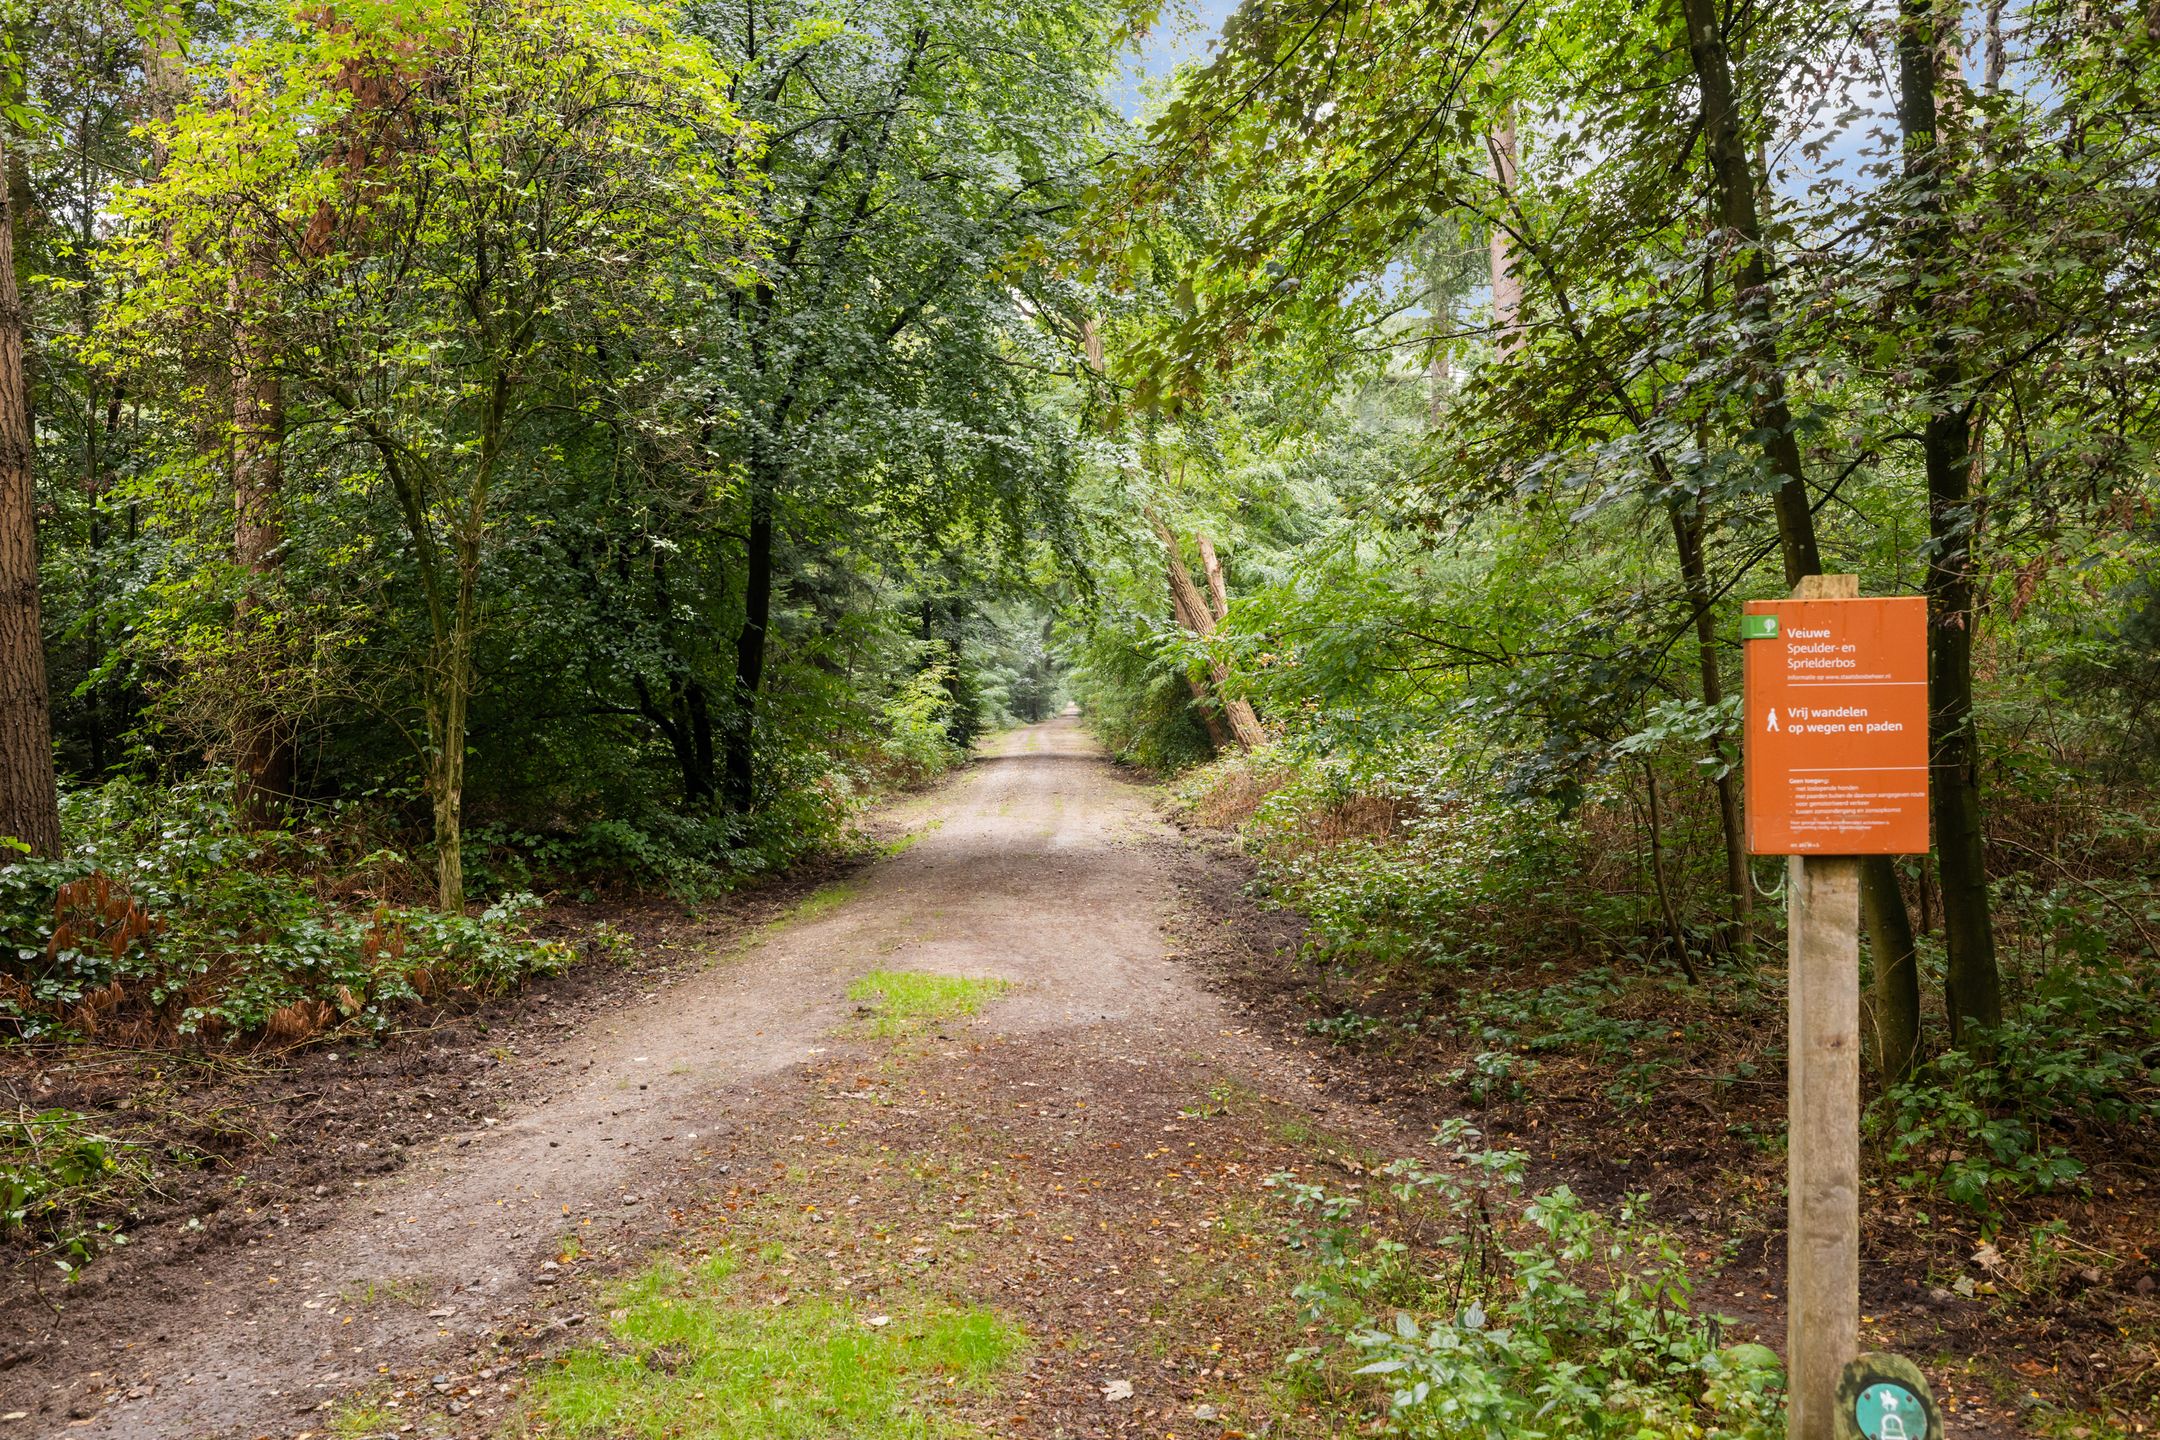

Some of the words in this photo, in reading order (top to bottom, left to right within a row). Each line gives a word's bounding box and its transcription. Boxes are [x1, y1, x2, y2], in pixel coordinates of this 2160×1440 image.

[1841, 644, 1856, 653] en
[1787, 658, 1856, 670] Sprielderbos
[1787, 707, 1808, 720] Vrij
[1811, 706, 1868, 718] wandelen
[1788, 724, 1804, 735] op
[1807, 723, 1846, 735] wegen
[1848, 723, 1863, 732] en
[1866, 720, 1903, 733] paden
